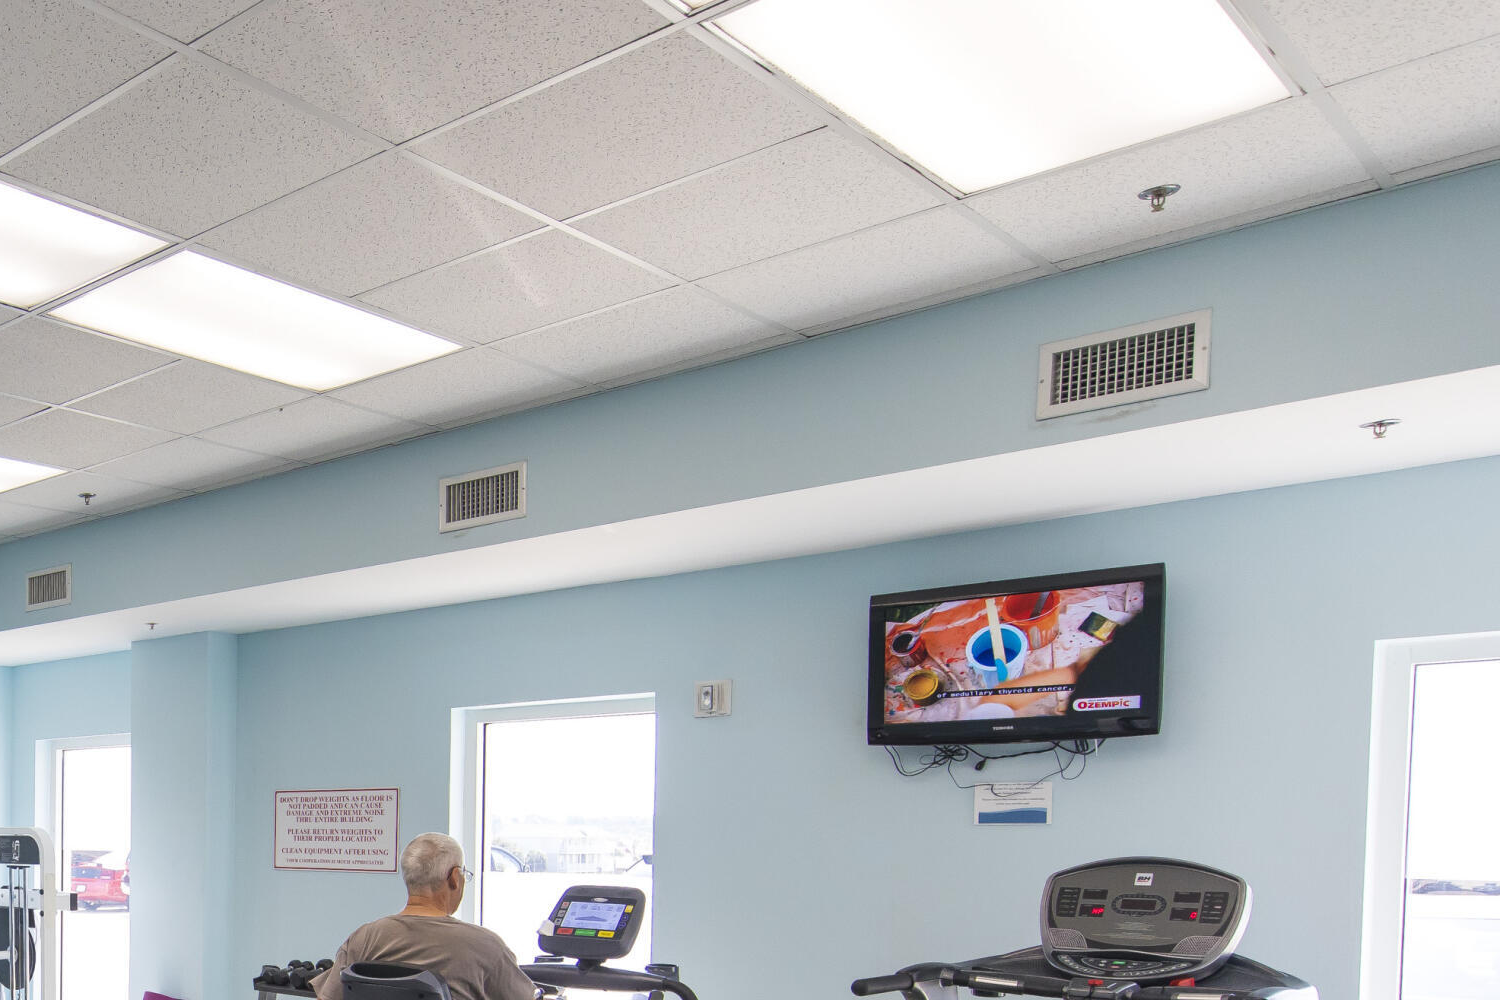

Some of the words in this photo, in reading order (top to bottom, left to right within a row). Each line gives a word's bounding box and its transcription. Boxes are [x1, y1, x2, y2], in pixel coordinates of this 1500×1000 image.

[950, 690, 993, 698] medullary
[998, 687, 1033, 695] thyroid
[1037, 685, 1072, 693] cancer.
